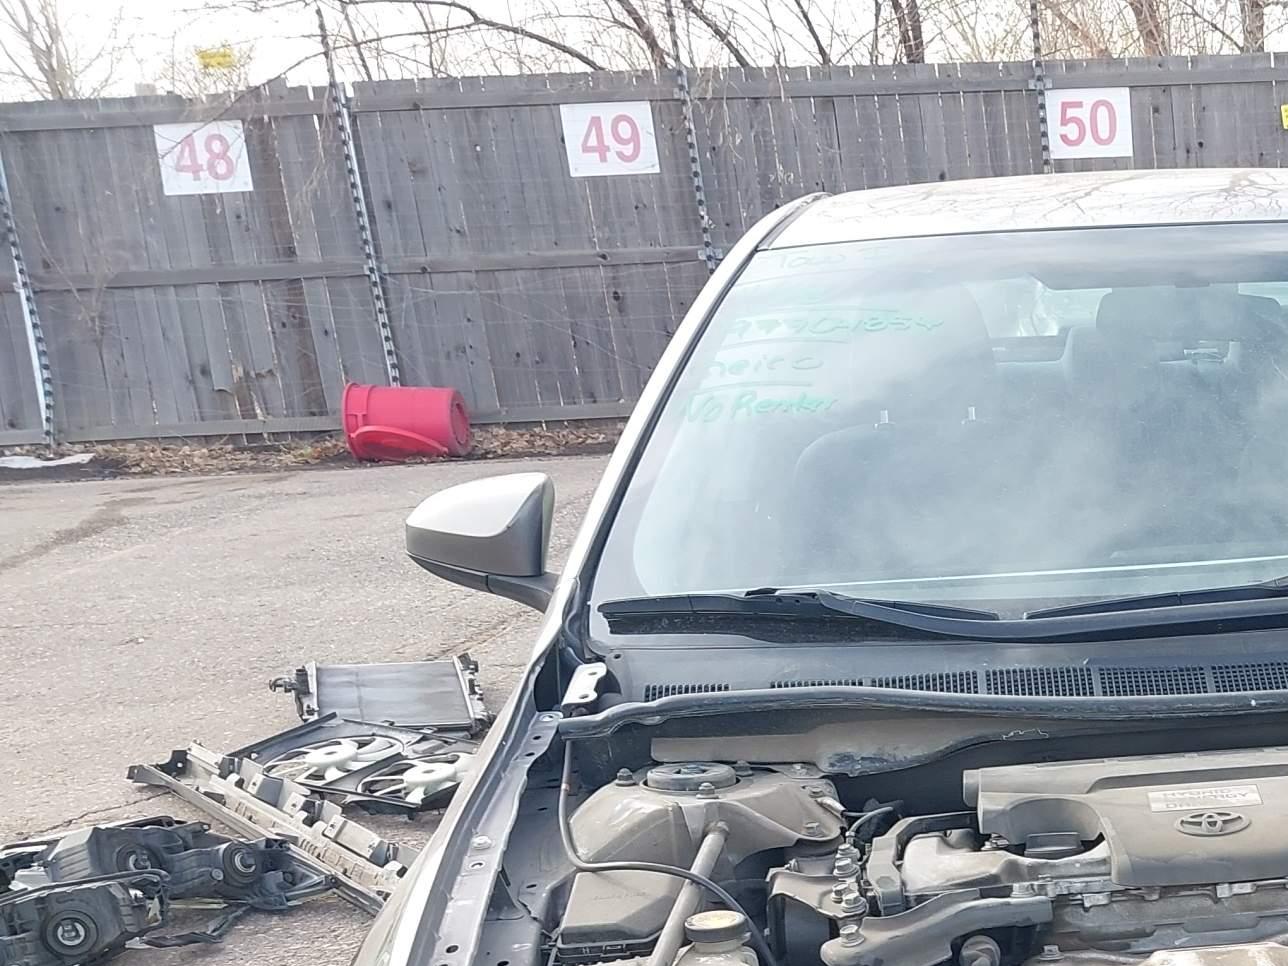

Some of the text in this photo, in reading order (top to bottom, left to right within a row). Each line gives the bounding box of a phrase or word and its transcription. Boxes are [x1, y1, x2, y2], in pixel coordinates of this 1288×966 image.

[581, 112, 643, 164] 49
[1058, 99, 1118, 147] 50
[174, 131, 236, 182] 48
